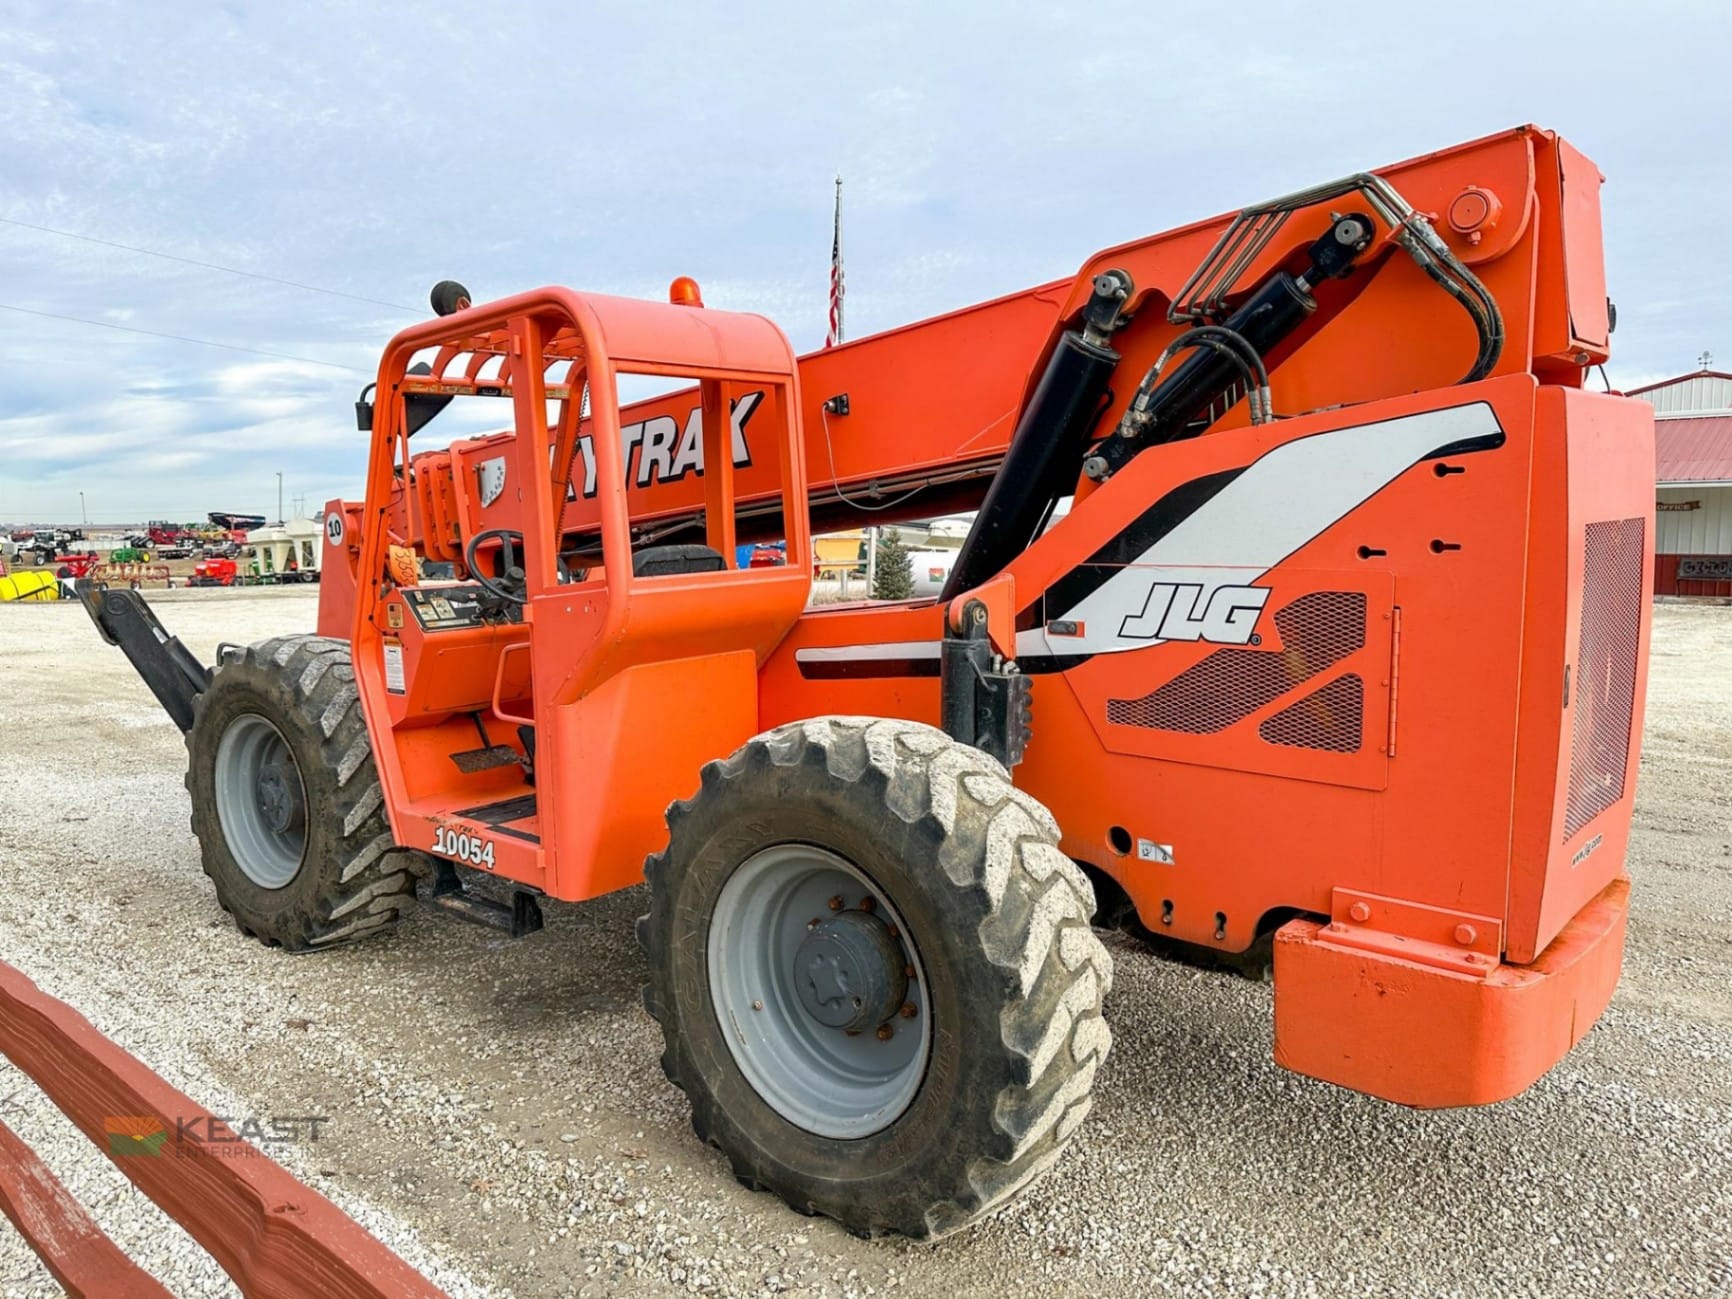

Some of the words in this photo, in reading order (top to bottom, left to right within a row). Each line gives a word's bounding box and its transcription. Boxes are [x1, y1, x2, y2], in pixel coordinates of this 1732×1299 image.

[328, 519, 342, 538] 10
[1684, 560, 1732, 575] CYCLO
[1117, 582, 1273, 645] JLG
[431, 825, 495, 869] 10054
